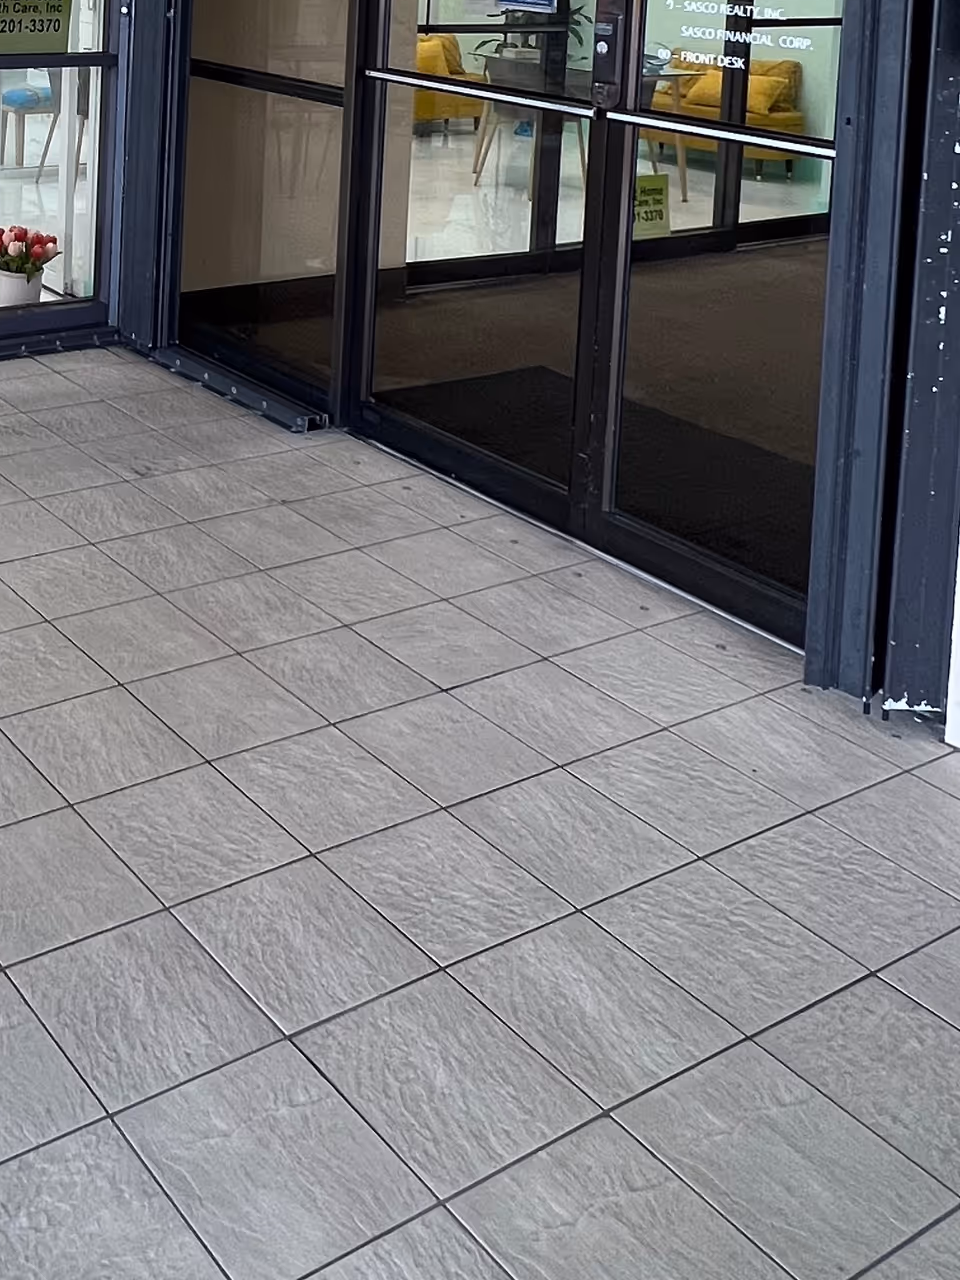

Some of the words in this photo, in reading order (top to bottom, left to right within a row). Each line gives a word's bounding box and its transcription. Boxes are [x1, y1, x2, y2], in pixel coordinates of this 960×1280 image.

[12, 2, 42, 15] Care,
[46, 2, 63, 13] Inc
[683, 1, 718, 14] SASCO
[680, 25, 715, 40] SASCO
[716, 29, 774, 46] FINANCIAL
[778, 35, 814, 50] CORP.
[680, 51, 716, 65] FRONT
[717, 54, 745, 70] DESK
